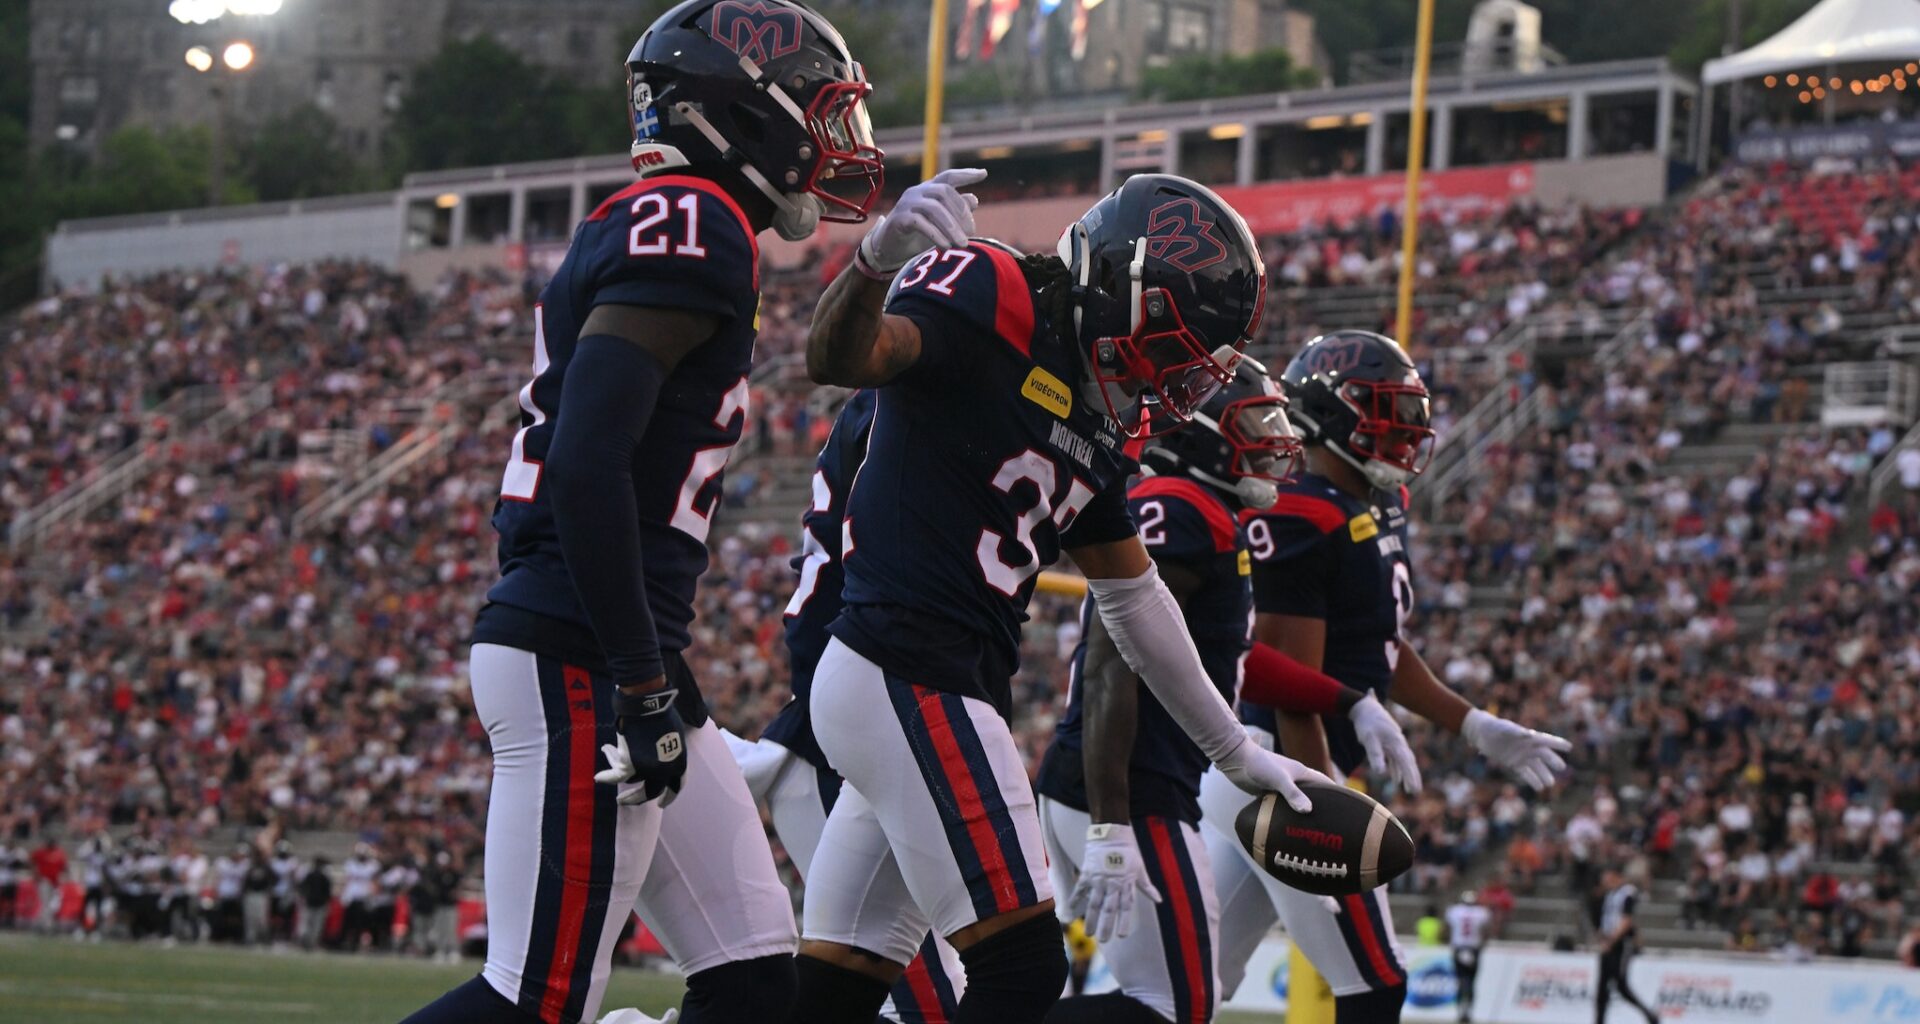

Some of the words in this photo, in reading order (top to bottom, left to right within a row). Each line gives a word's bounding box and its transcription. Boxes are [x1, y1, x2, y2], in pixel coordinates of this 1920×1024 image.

[628, 191, 707, 258] 21
[898, 248, 977, 297] 37
[1030, 378, 1068, 407] VIDÉOTRON
[1094, 430, 1116, 449] SPORTS
[1246, 518, 1276, 562] 9
[660, 738, 679, 755] CFL
[1285, 824, 1344, 850] Wilson
